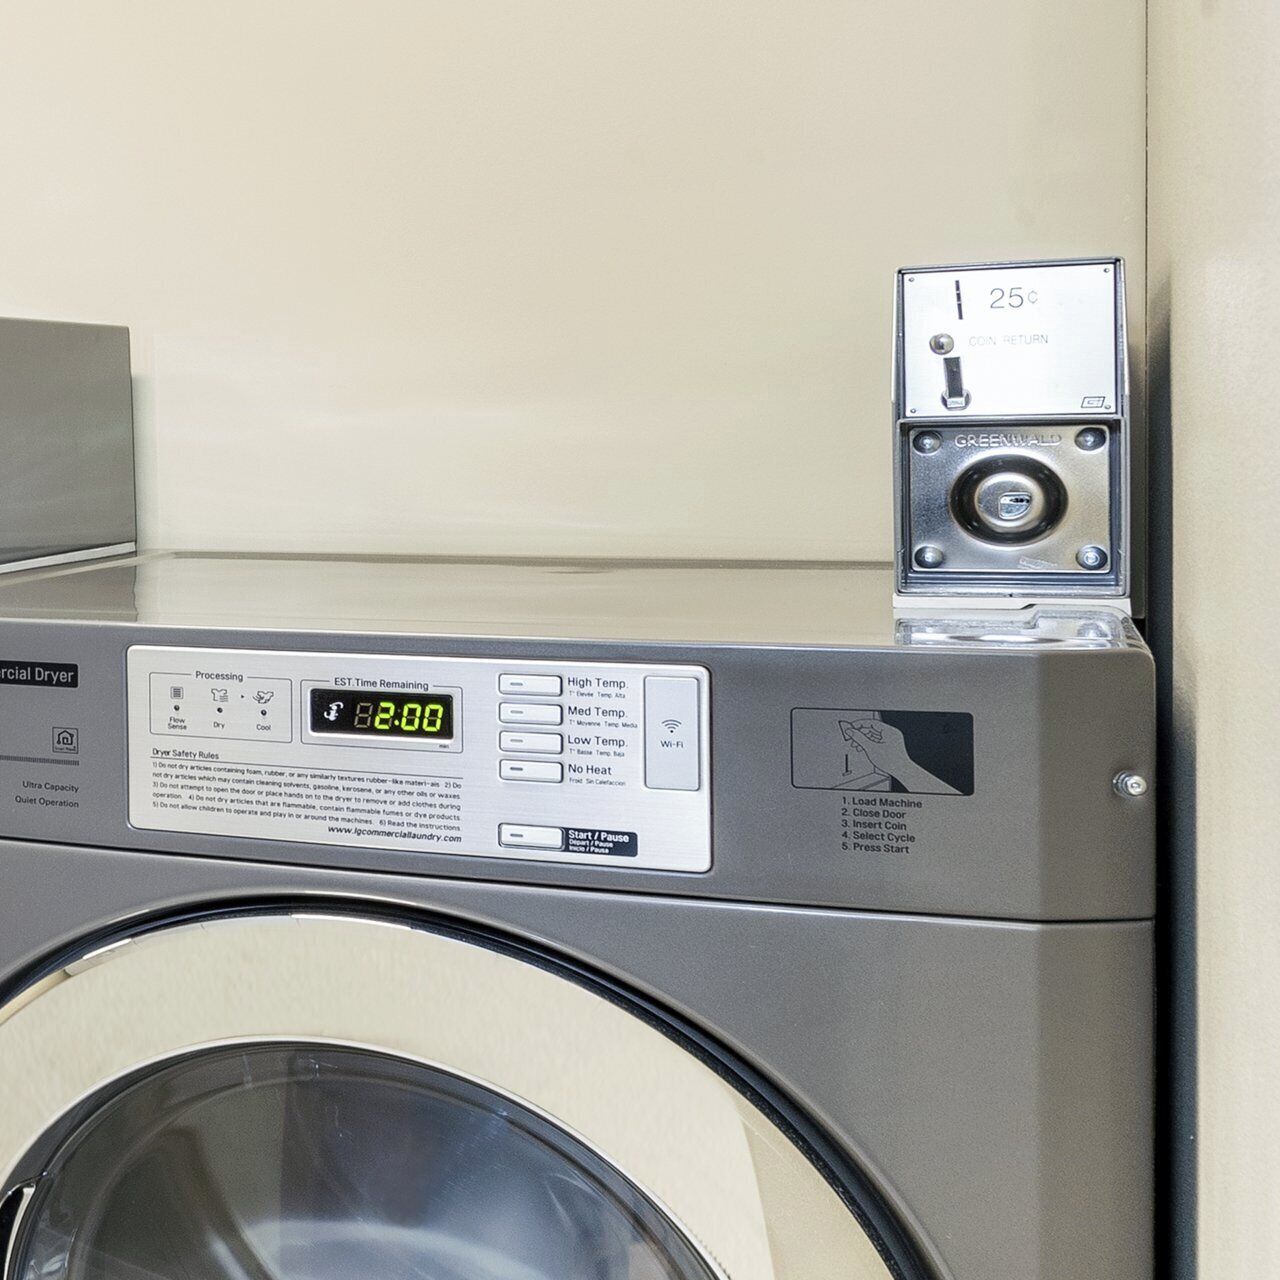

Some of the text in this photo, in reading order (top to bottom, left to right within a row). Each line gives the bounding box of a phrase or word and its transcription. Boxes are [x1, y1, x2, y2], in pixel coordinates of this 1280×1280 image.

[990, 287, 1038, 309] 25¢
[968, 334, 1049, 347] COIN RETURN
[955, 434, 1062, 447] GREENWALD
[35, 668, 74, 684] Dryer
[195, 670, 243, 682] Processing
[380, 680, 429, 691] Remaining
[568, 677, 629, 690] High Temp.
[568, 706, 628, 719] Med Temp.
[167, 723, 187, 731] Sense
[213, 721, 225, 730] Dry
[256, 723, 271, 731] Cool
[568, 735, 628, 748] Low Temp.
[660, 740, 684, 749] Wi-Fi
[152, 748, 220, 759] Dryer Safety Rules
[568, 764, 612, 775] No Heat
[22, 780, 79, 793] Ultra Capacity
[15, 796, 79, 808] Quiet Operation
[852, 797, 877, 807] Load
[879, 799, 922, 809] Machine
[841, 808, 906, 819] 2. Close Door
[841, 819, 907, 831] 3. Insert Coin
[569, 830, 592, 840] Start
[600, 832, 630, 843] Pause
[841, 831, 916, 844] 4. Select Cycle
[841, 842, 909, 854] 5. Press Start
